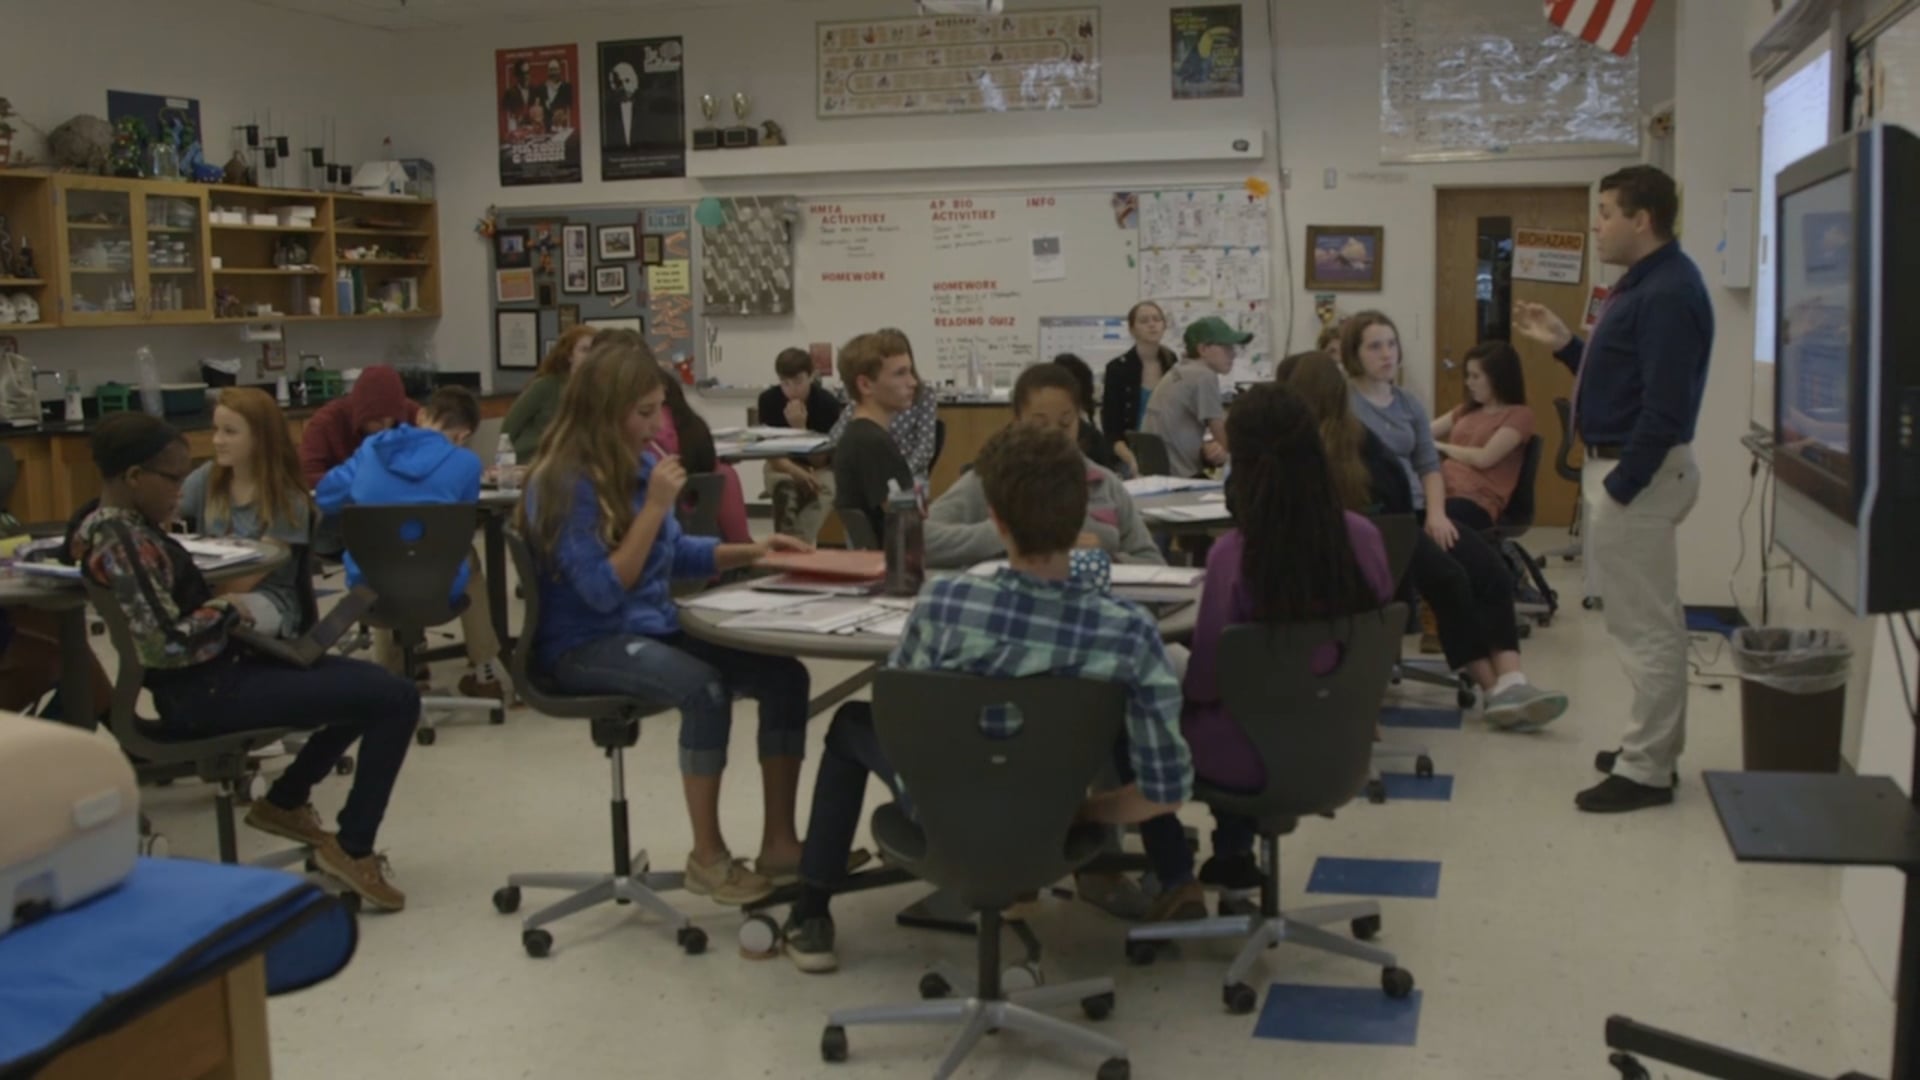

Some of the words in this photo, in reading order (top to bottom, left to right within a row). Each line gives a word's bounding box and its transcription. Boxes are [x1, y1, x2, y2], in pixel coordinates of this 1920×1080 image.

[930, 199, 946, 209] AP
[952, 198, 974, 209] BIO
[1027, 197, 1055, 208] INFO
[821, 213, 886, 224] ACTIVITIES
[931, 210, 997, 221] ACTIVITIES
[1518, 231, 1581, 250] BIOHAZARD
[821, 271, 886, 281] HOMEWORK
[933, 279, 998, 291] HOMEWORK
[934, 316, 984, 328] READING
[988, 316, 1016, 327] QUIZ
